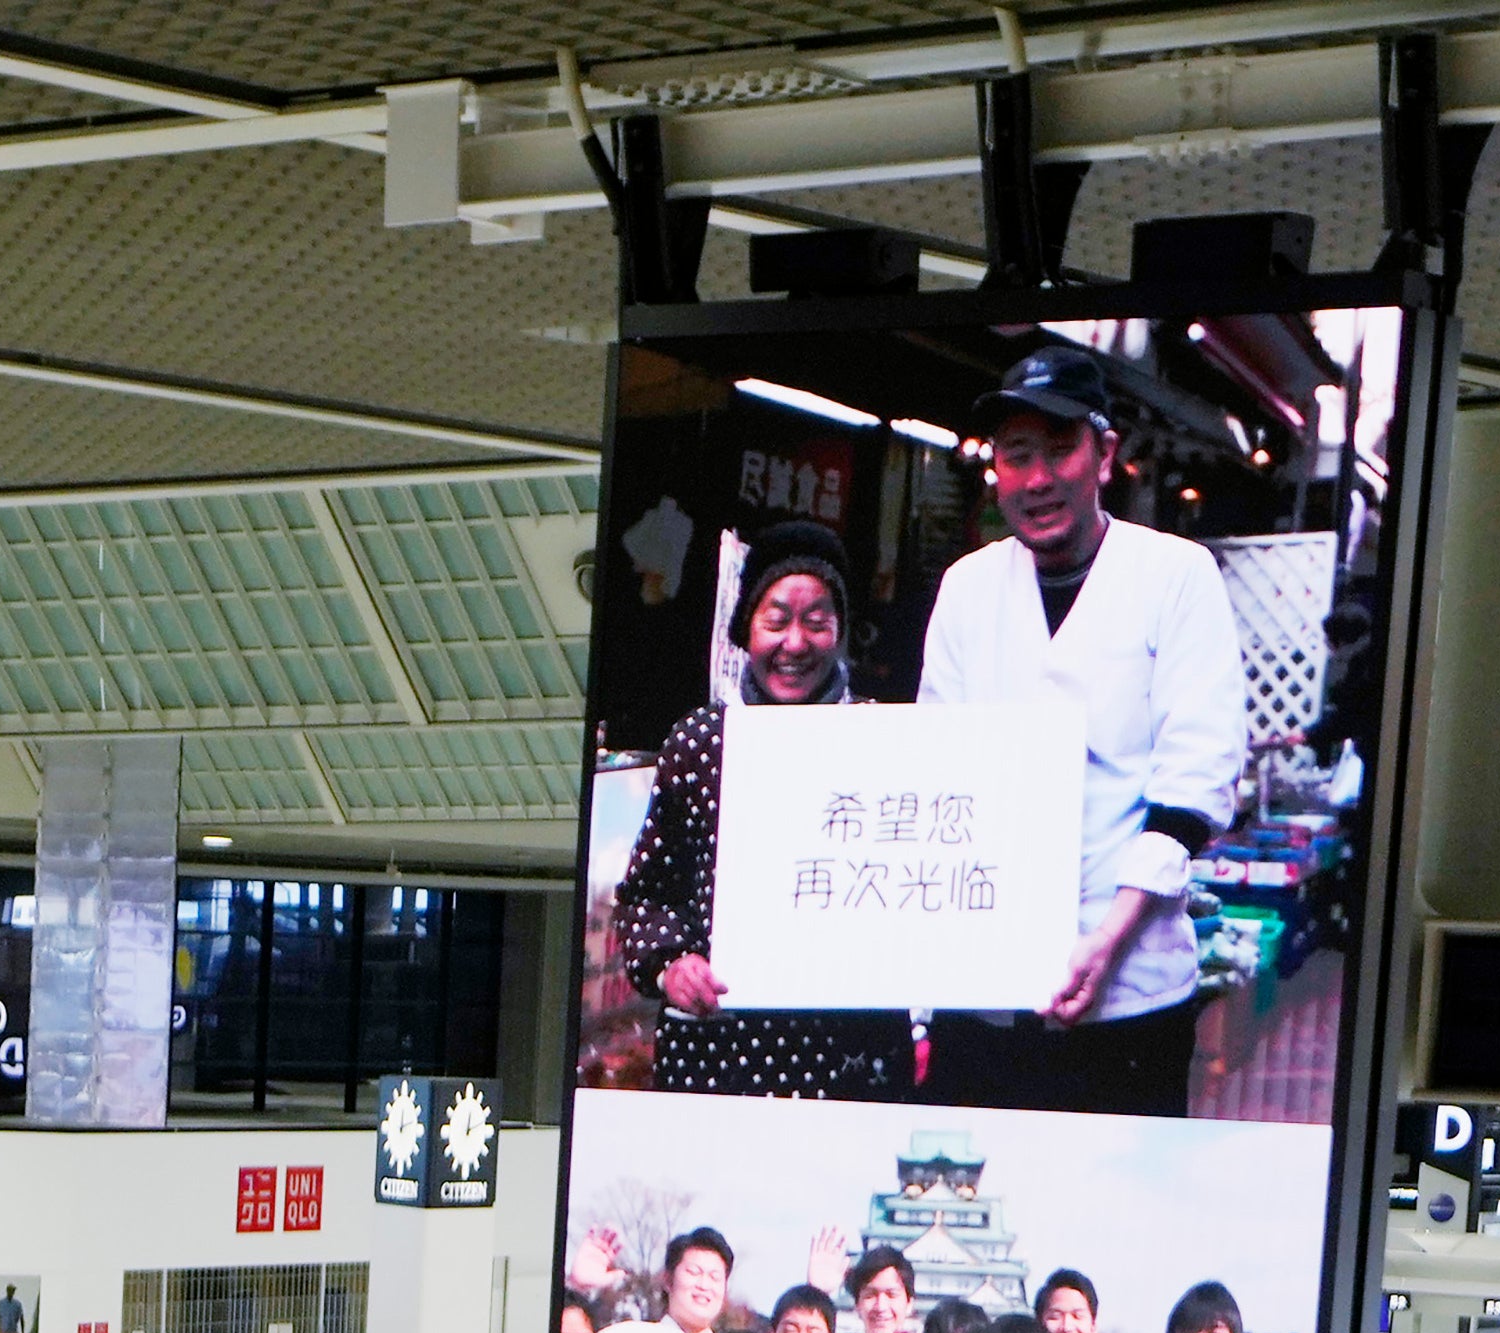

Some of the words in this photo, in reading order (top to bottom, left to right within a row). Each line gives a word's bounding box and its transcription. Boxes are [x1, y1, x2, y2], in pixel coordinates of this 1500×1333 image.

[831, 791, 974, 844] 希望您
[792, 858, 999, 912] 再次光临
[1434, 1104, 1473, 1151] D
[289, 1174, 317, 1197] UNI
[380, 1176, 419, 1200] CITIZEN
[440, 1180, 488, 1201] CITIZEN
[287, 1201, 317, 1228] QLO
